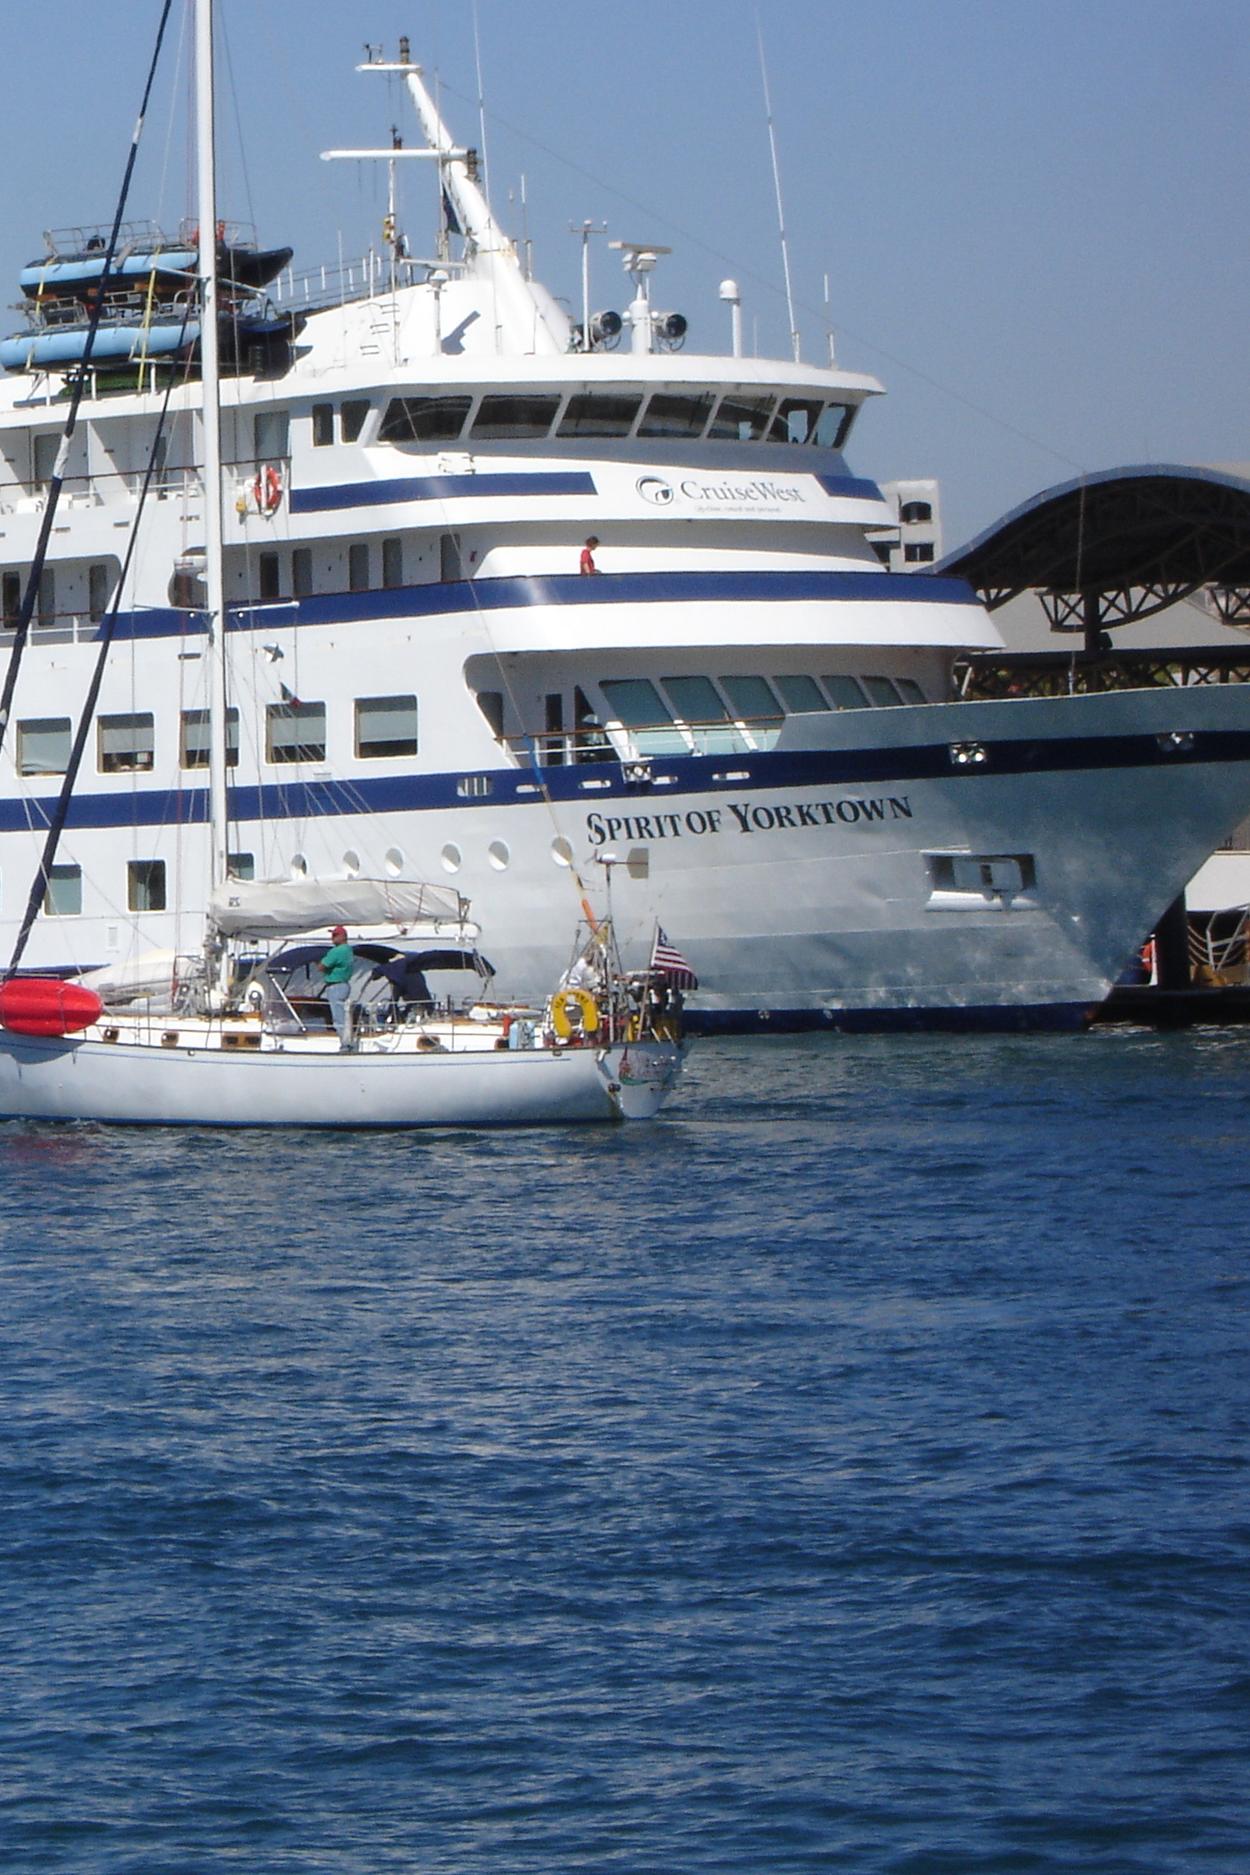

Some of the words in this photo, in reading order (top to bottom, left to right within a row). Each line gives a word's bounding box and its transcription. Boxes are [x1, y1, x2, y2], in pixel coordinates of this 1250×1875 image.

[680, 480, 806, 502] CruiseWest
[587, 812, 682, 846] SPIRIT
[685, 810, 722, 835] OF
[727, 796, 913, 834] YORKTOWN
